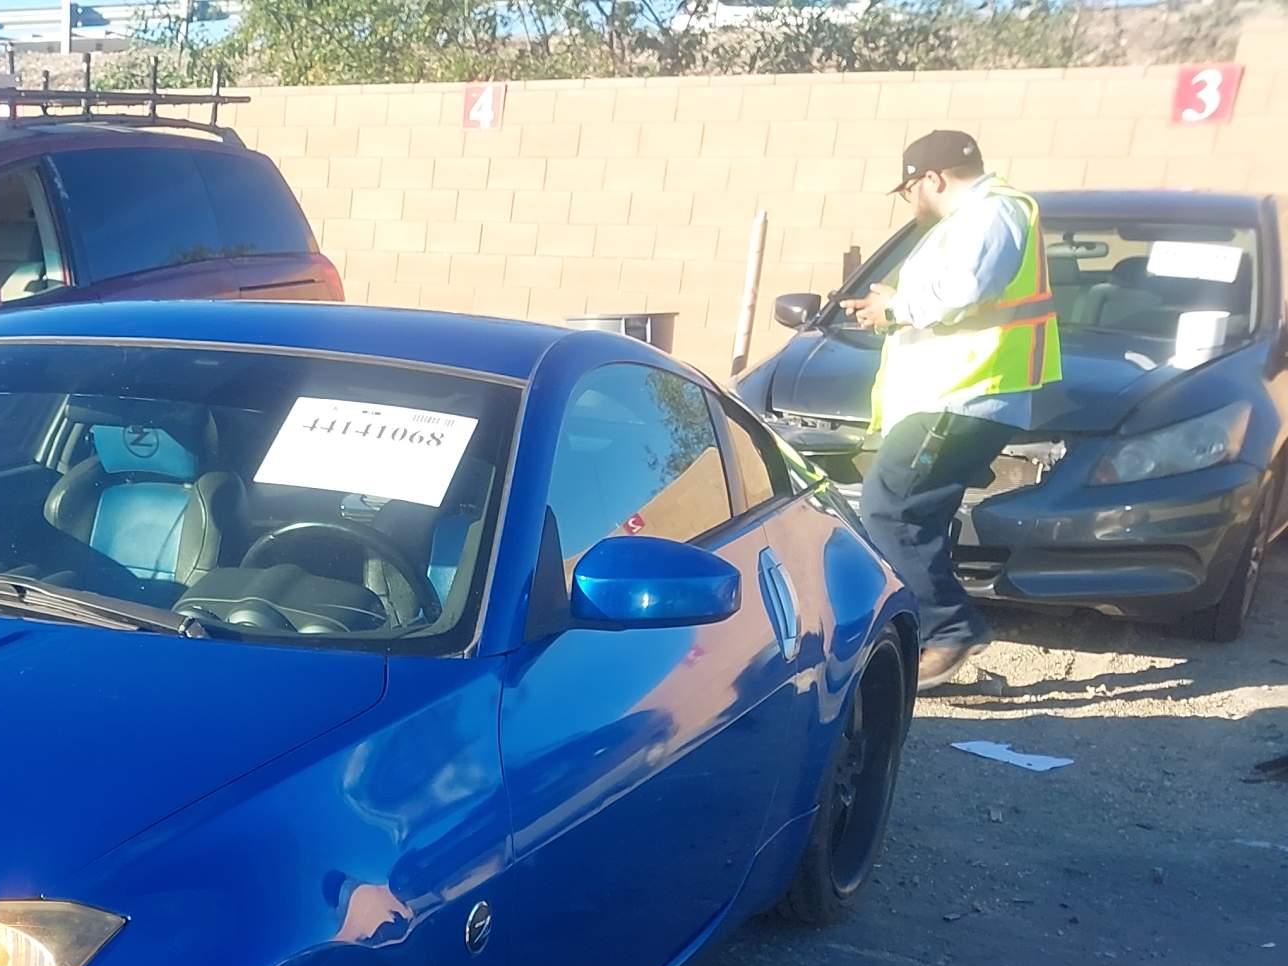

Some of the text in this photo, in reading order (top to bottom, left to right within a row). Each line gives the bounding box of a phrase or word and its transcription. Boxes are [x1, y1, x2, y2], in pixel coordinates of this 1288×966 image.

[469, 80, 494, 128] 4
[1181, 68, 1223, 121] 3
[302, 416, 445, 447] 44141068
